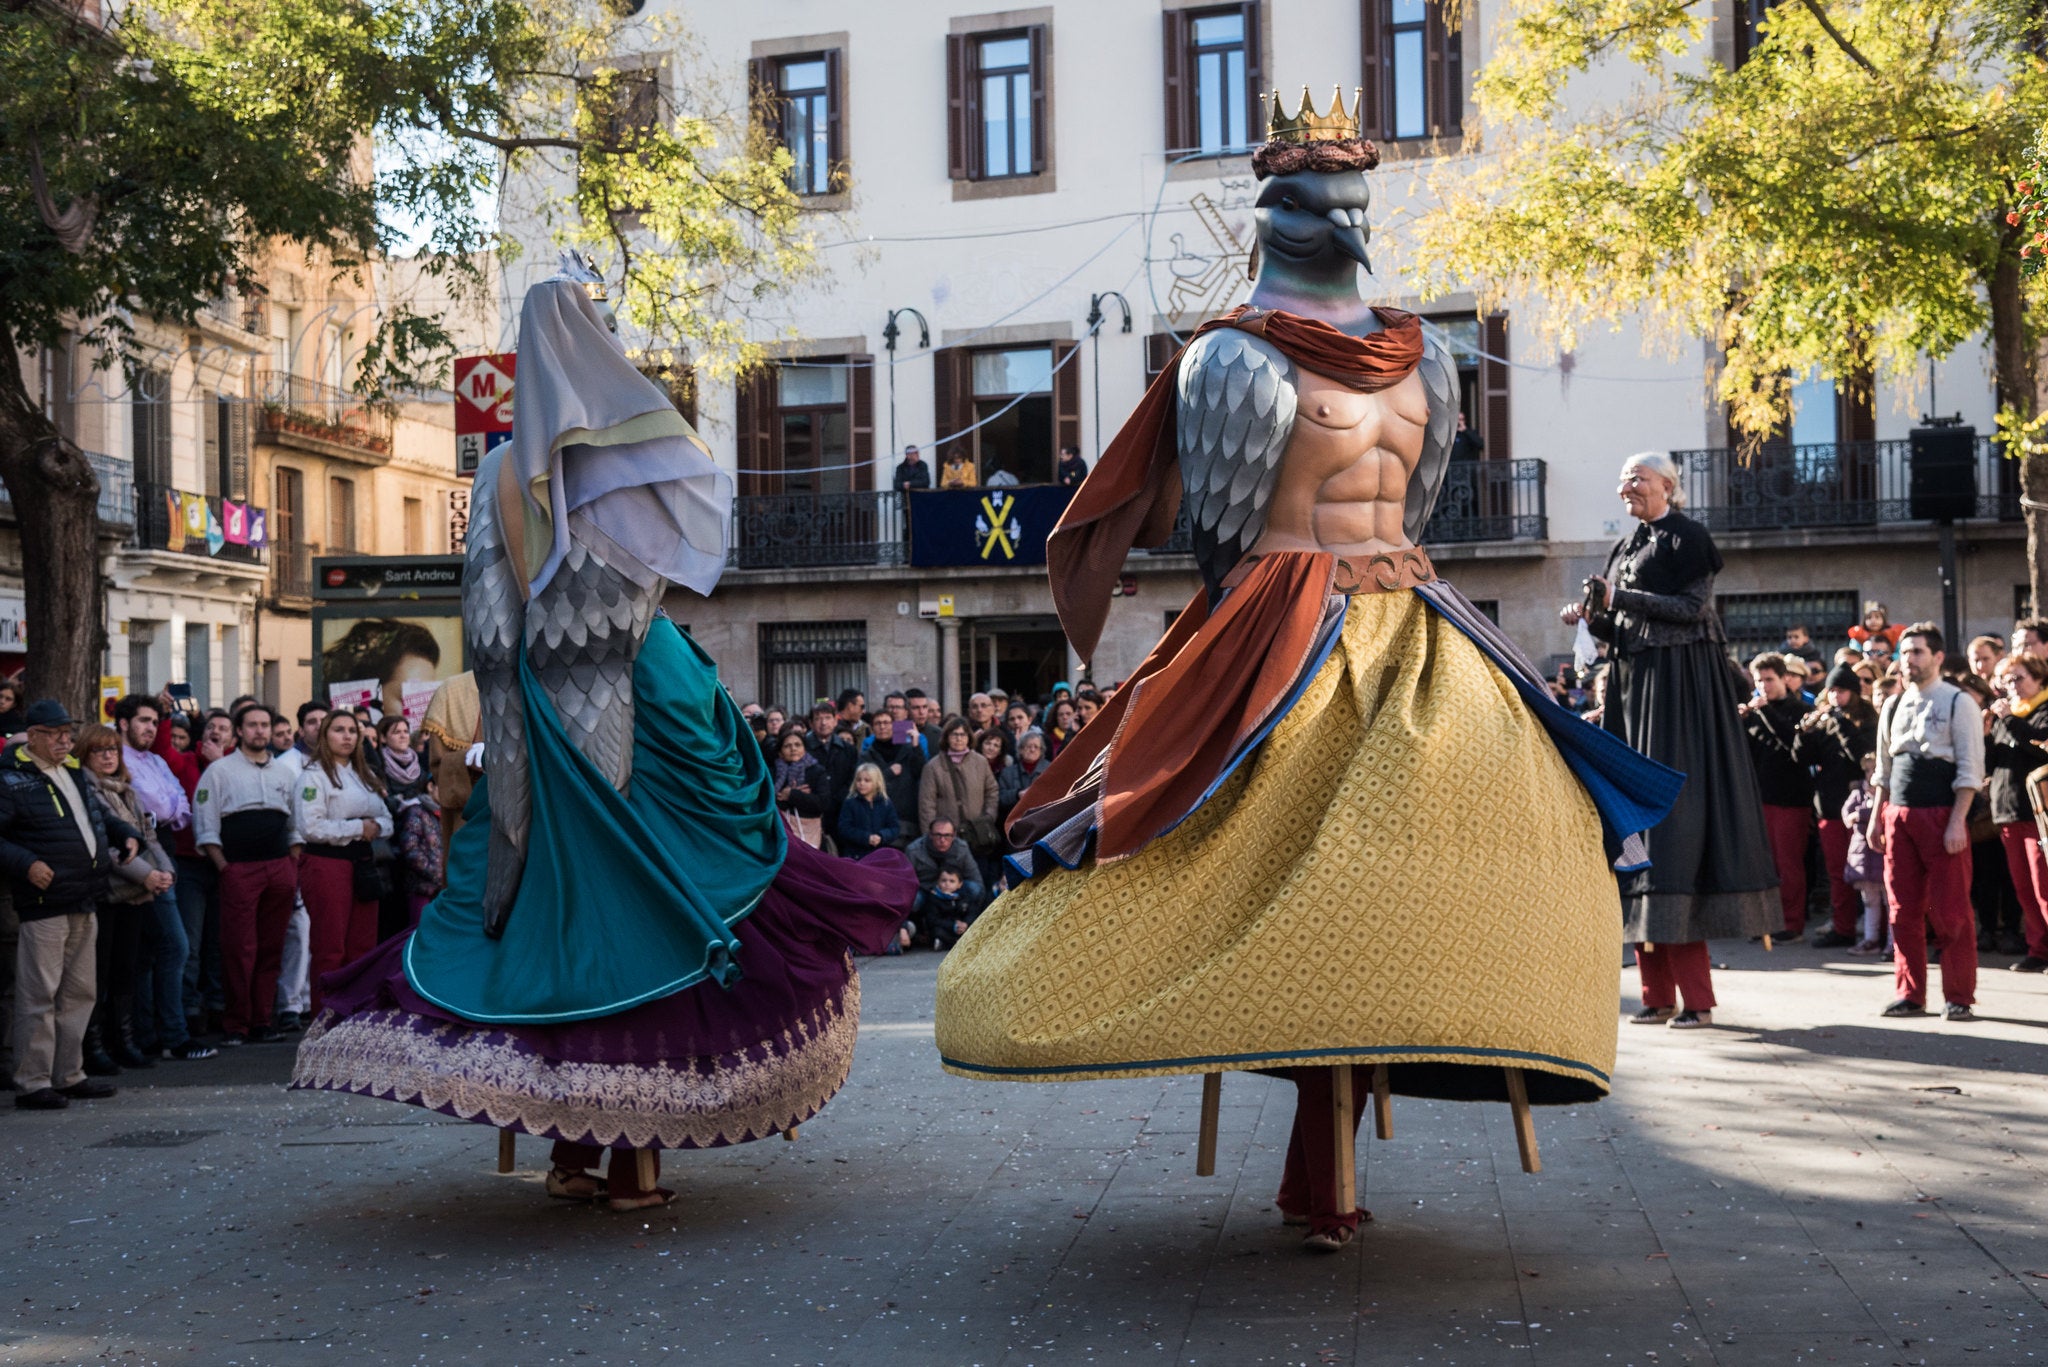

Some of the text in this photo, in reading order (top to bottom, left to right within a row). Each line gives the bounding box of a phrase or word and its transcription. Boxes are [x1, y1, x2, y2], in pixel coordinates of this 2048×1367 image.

[472, 373, 495, 398] M
[385, 569, 456, 582] Sant Andreu
